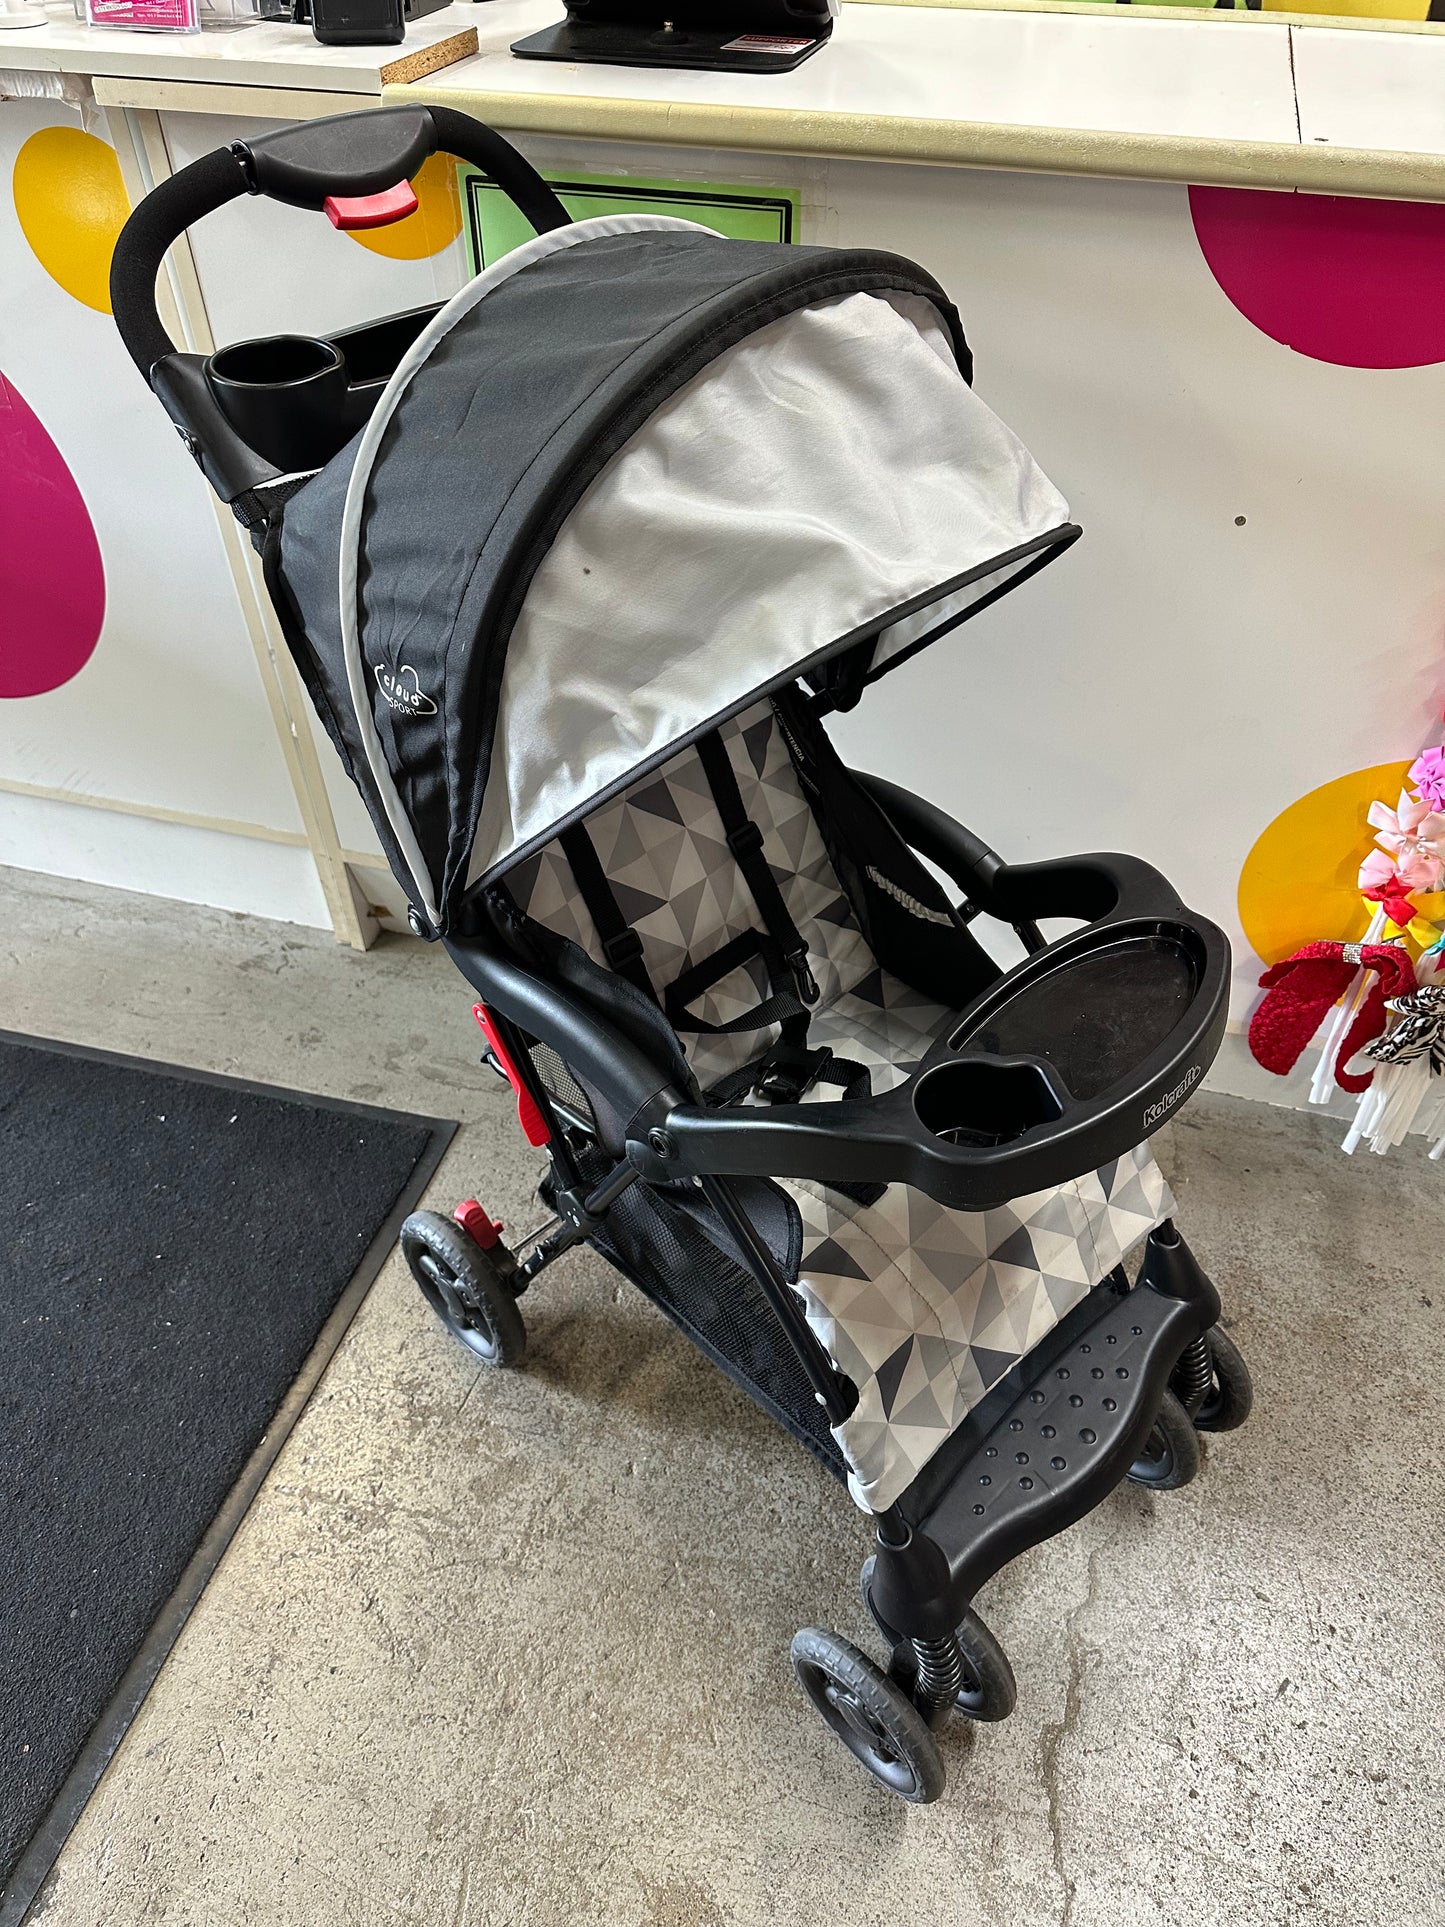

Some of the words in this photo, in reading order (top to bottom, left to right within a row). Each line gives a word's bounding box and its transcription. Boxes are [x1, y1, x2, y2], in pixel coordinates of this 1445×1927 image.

[383, 674, 422, 707] cloud
[388, 697, 418, 717] SPORT
[1143, 1066, 1197, 1128] Kolcraft
